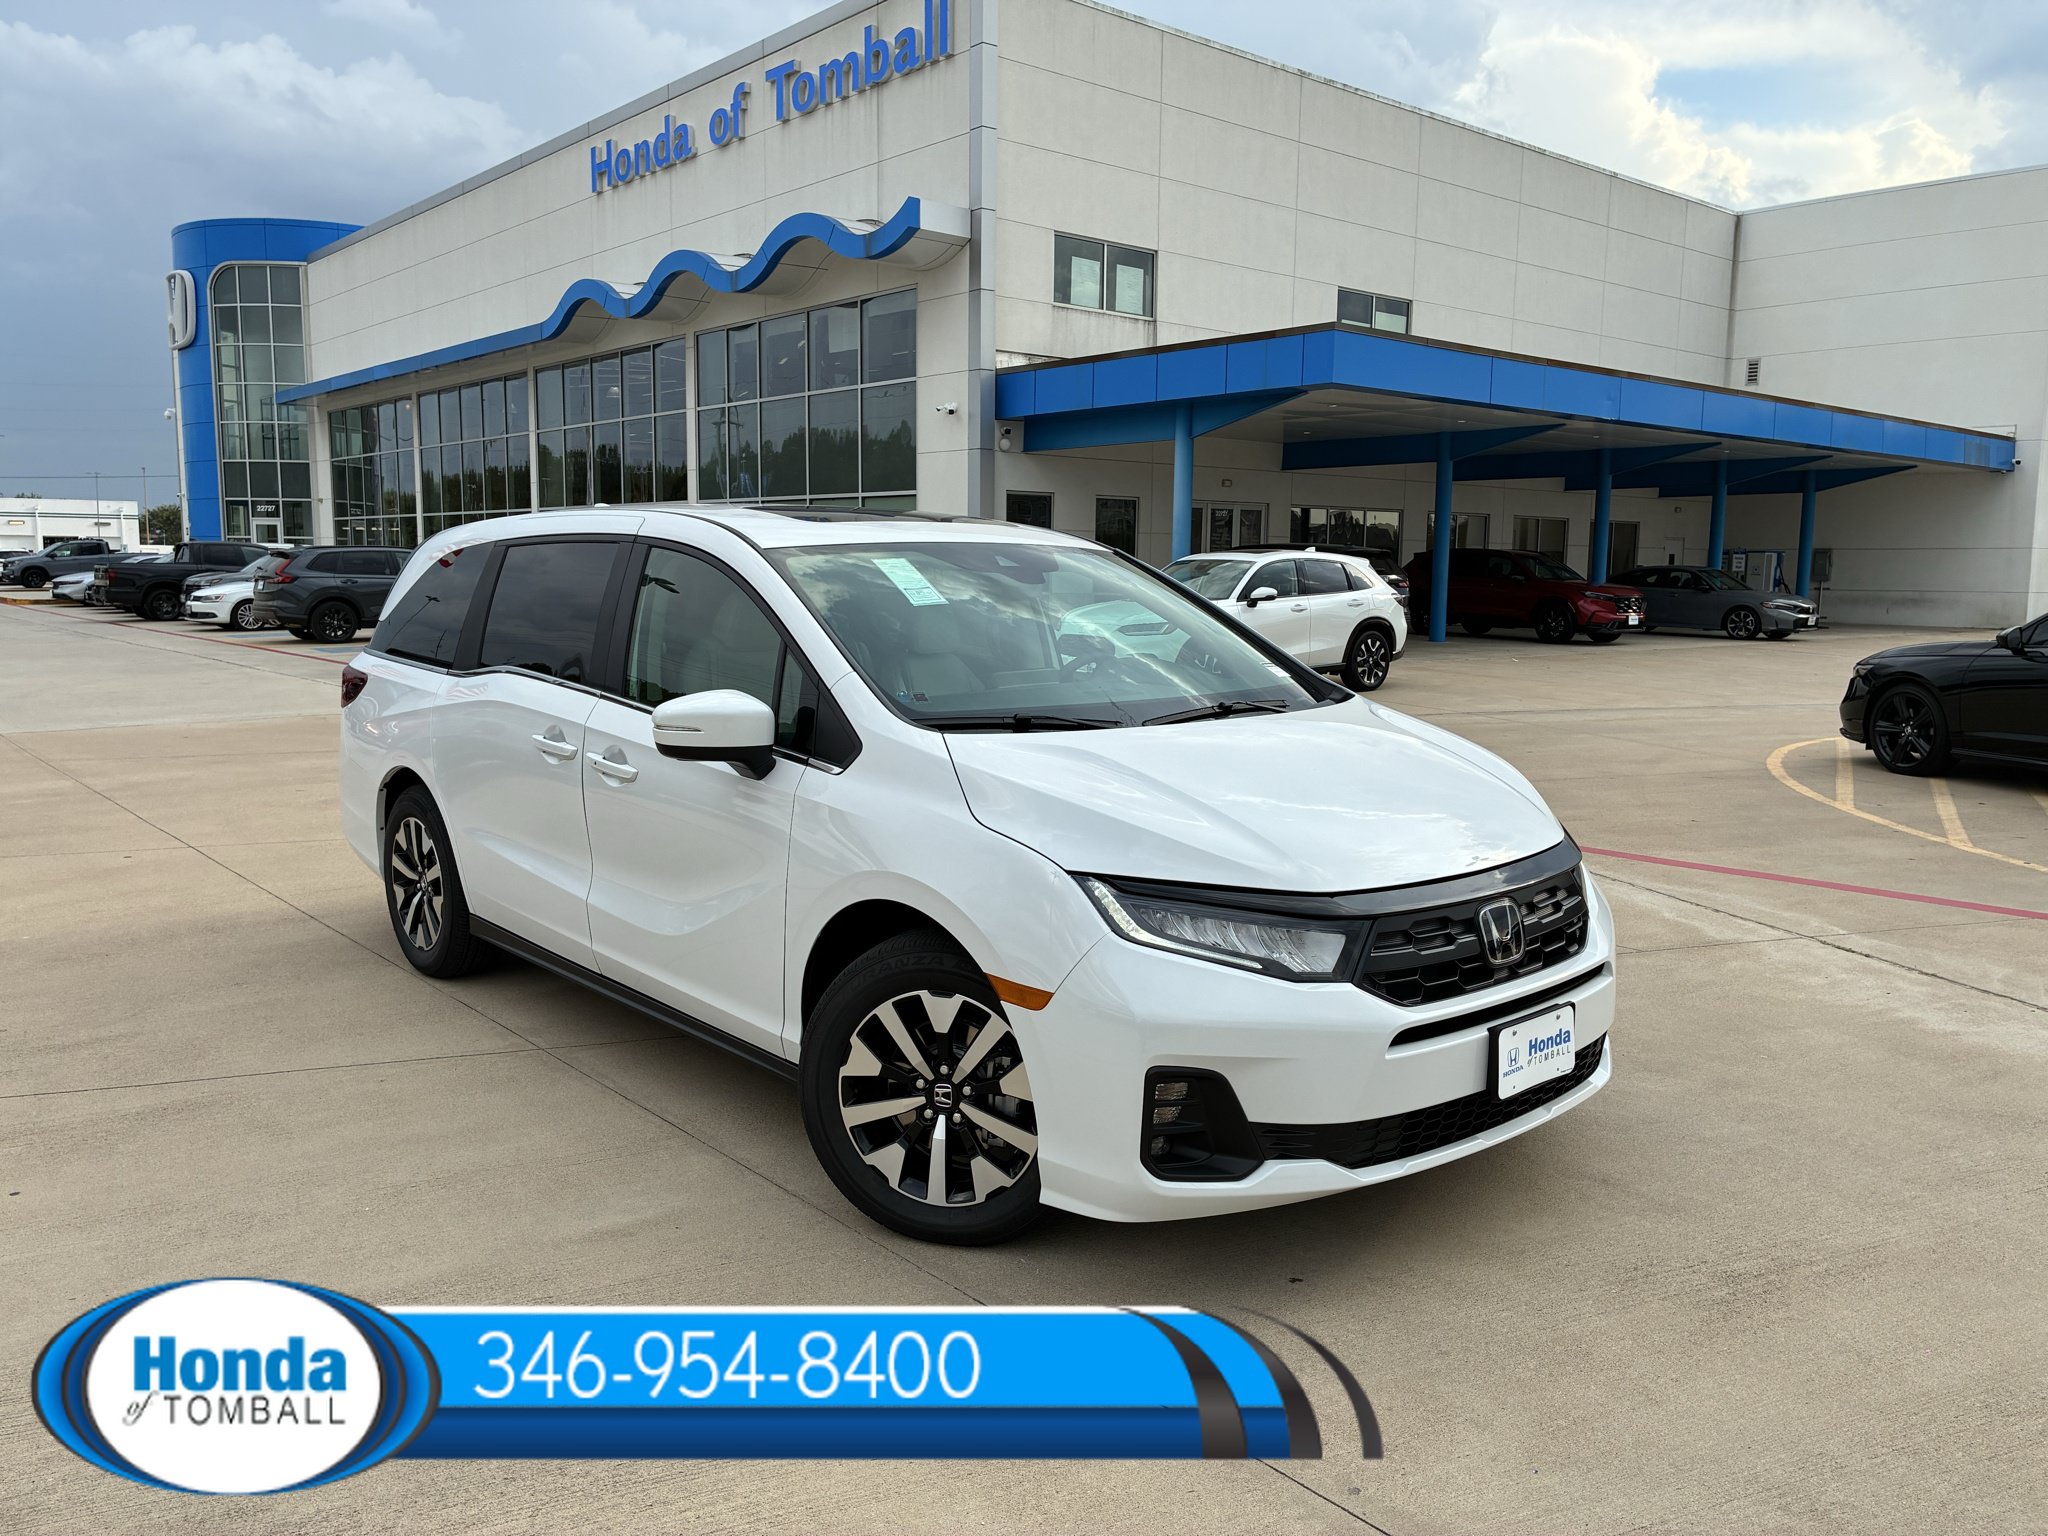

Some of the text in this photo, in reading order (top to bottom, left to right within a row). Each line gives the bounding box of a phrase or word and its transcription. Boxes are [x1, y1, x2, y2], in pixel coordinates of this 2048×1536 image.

[590, 0, 952, 194] Honda of Tomball
[1528, 1027, 1571, 1057] Honda
[1534, 1045, 1571, 1065] TOMBALL
[1502, 1065, 1524, 1078] HONDA
